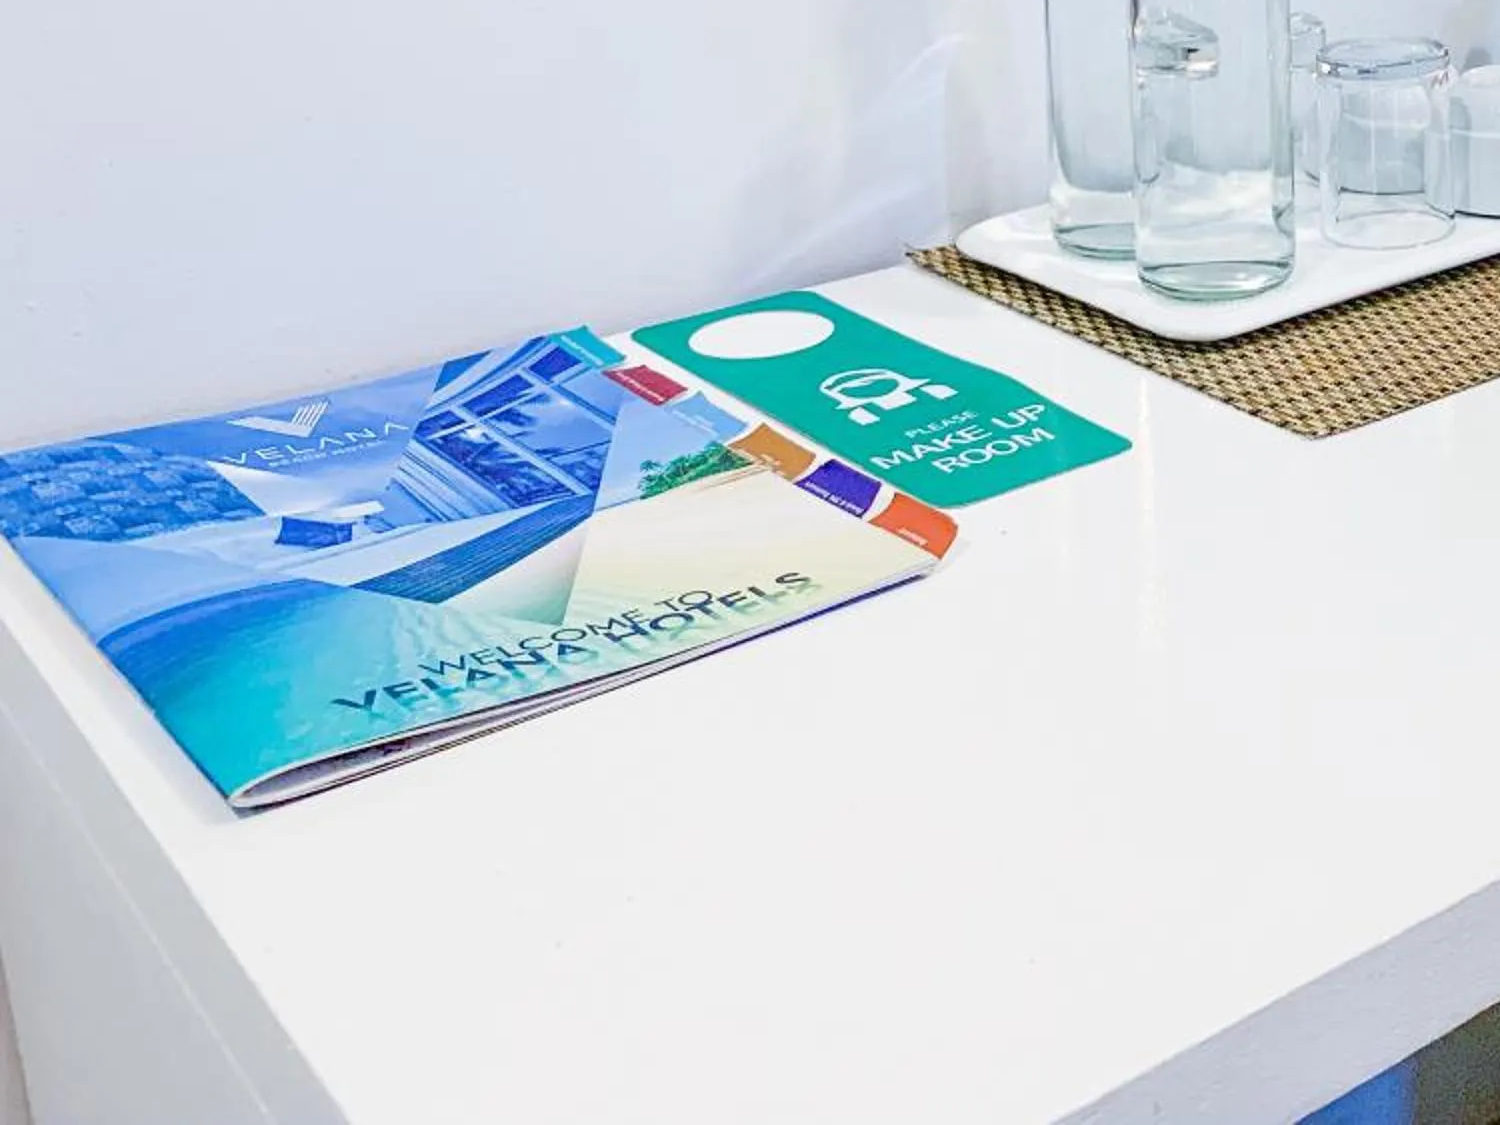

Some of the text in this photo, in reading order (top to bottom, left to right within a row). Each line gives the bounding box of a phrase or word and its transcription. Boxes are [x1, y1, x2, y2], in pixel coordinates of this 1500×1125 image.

[868, 403, 1046, 470] MAKE UP
[904, 410, 979, 438] PLEASE
[931, 427, 1056, 473] ROOM
[330, 571, 812, 712] VELANA HOTELS
[417, 589, 713, 676] WELCOME TO
